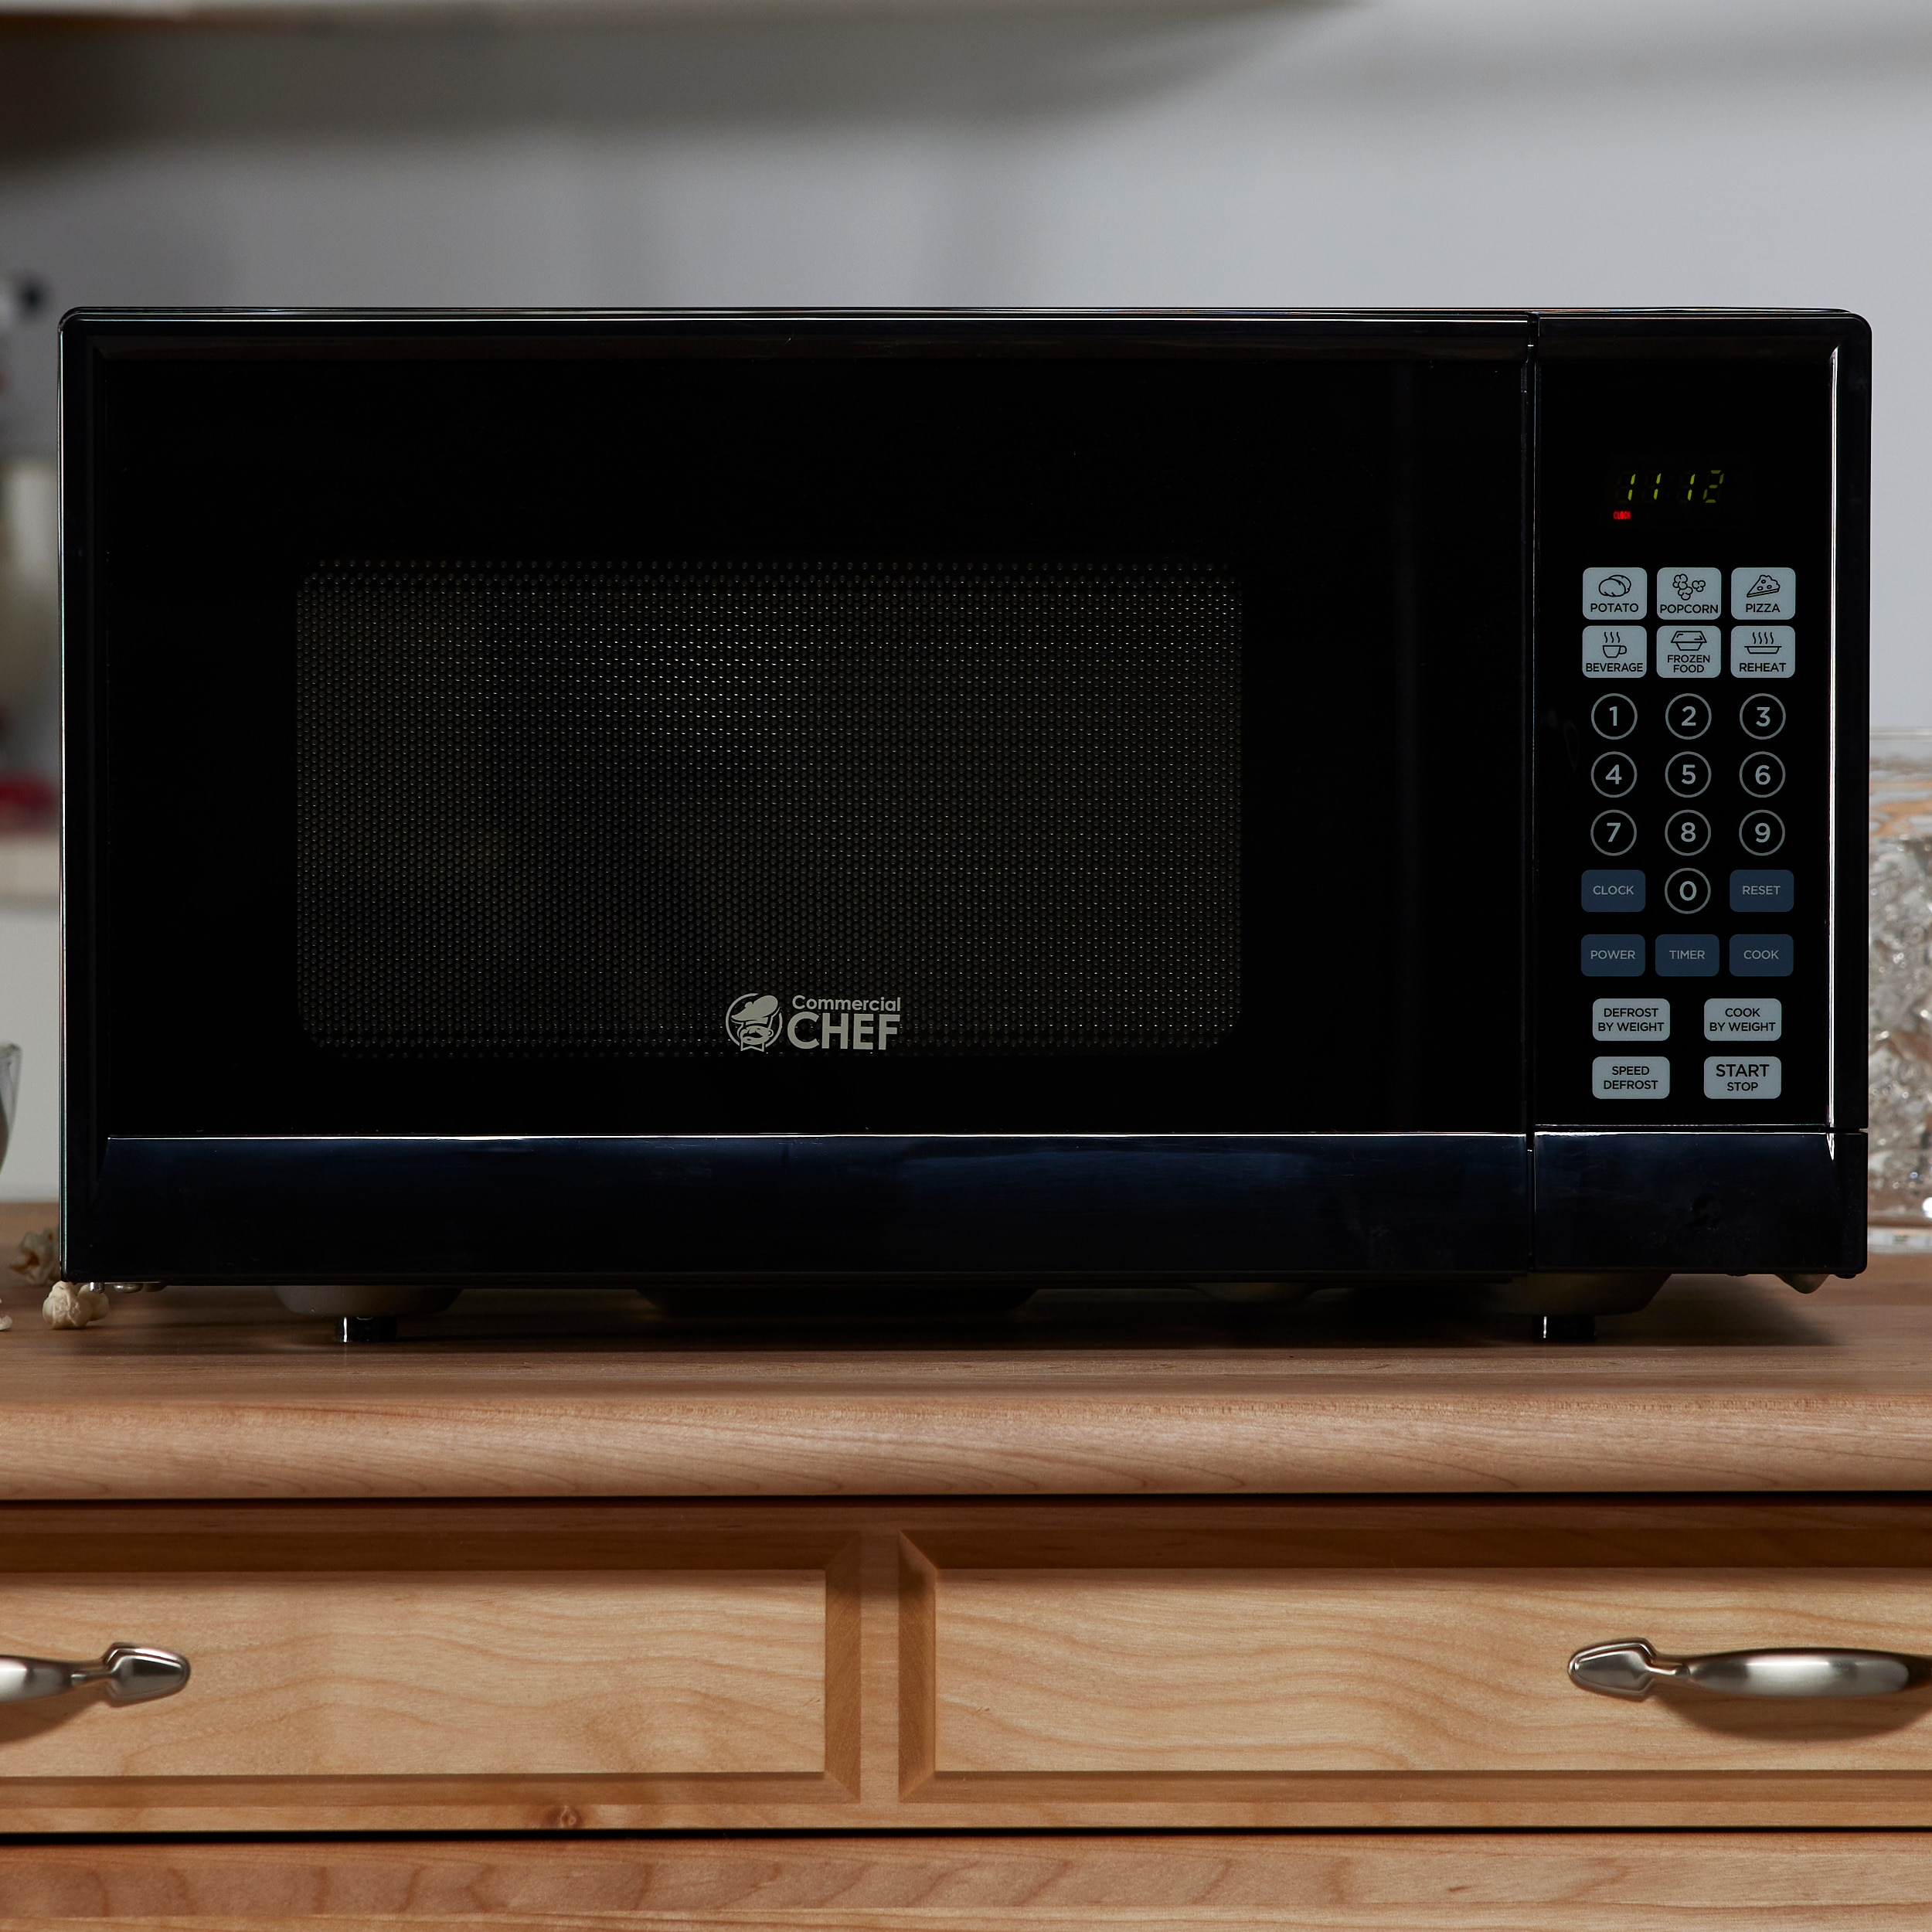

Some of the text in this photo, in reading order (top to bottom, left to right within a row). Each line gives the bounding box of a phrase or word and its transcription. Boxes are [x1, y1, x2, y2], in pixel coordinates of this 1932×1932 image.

[1590, 603, 1639, 613] POTATO
[1659, 604, 1719, 614] POPCORN
[1745, 603, 1781, 613] PIZZA
[1667, 654, 1710, 663] FROZEN
[1585, 662, 1644, 672] BEVERAGE
[1673, 664, 1705, 673] FOOD
[1739, 662, 1787, 672] REHEAT
[1609, 706, 1617, 726] 1
[1681, 706, 1696, 726] 2
[1756, 706, 1770, 727] 3
[1605, 764, 1622, 785] 4
[1681, 764, 1696, 785] 5
[1755, 764, 1771, 785] 6
[1606, 822, 1621, 842] 7
[1680, 821, 1696, 842] 8
[1754, 822, 1770, 843] 9
[1593, 885, 1634, 896] CLOCK
[1679, 880, 1697, 902] 0
[1742, 885, 1781, 896] RESET
[1590, 950, 1636, 960] POWER
[1668, 950, 1706, 960] TIMER
[1743, 950, 1780, 960] COOK
[792, 995, 901, 1012] Commercial
[1604, 1008, 1659, 1018] DEFROST
[1725, 1008, 1760, 1018] COOK
[787, 1012, 900, 1050] CHEF
[1597, 1022, 1665, 1032] BY WEIGHT
[1709, 1022, 1776, 1032] BY WEIGHT
[1611, 1066, 1650, 1076] SPEED
[1716, 1063, 1770, 1077] START
[1604, 1080, 1658, 1090] DEFROST
[1726, 1081, 1759, 1092] STOP
